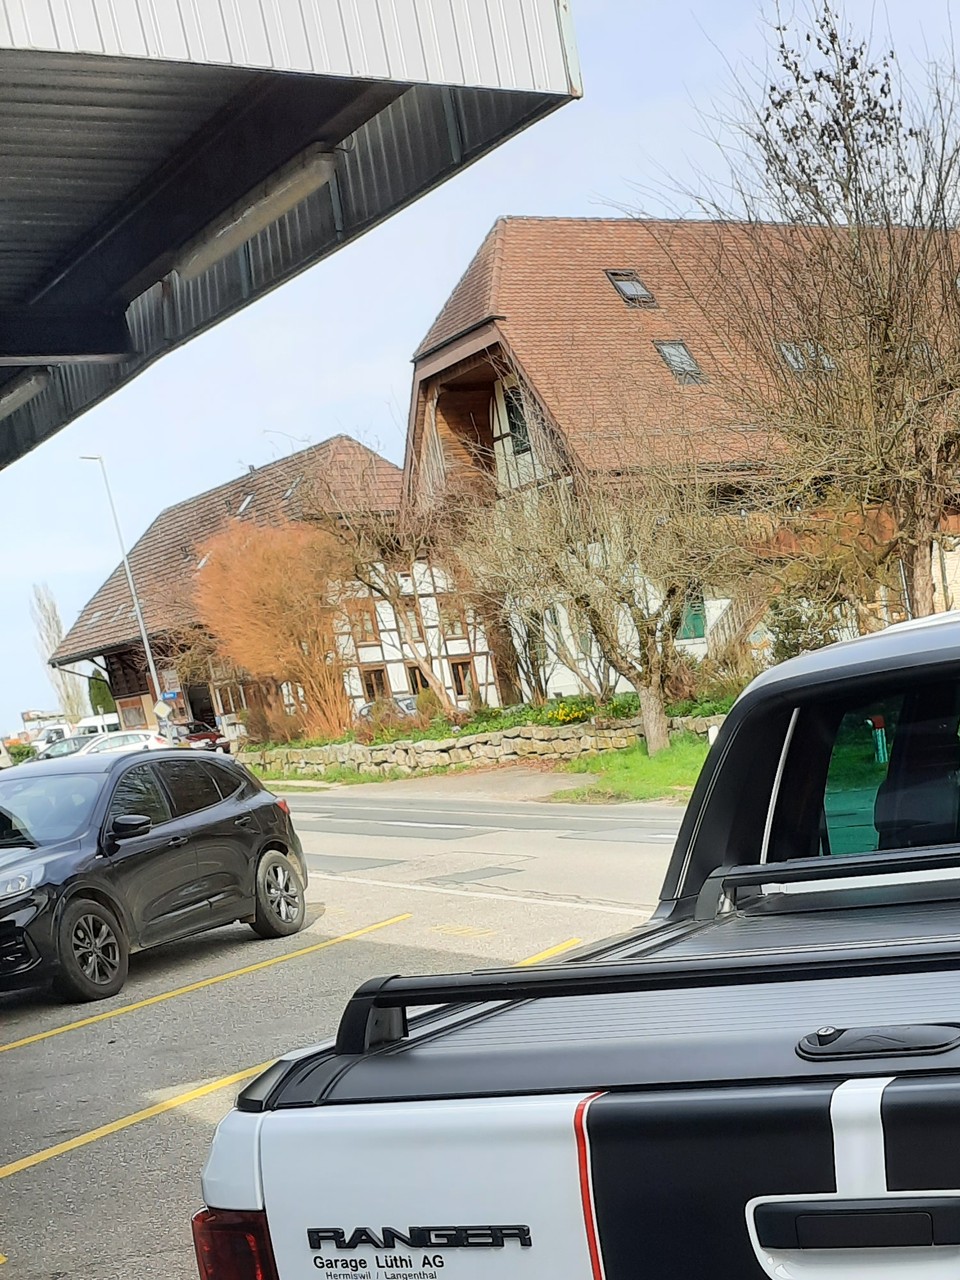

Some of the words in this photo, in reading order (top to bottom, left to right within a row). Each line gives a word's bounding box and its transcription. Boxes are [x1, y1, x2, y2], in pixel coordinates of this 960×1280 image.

[306, 1224, 533, 1250] RANGER
[313, 1255, 367, 1272] Garage
[376, 1255, 413, 1269] Lüthi
[421, 1255, 445, 1268] AG
[325, 1271, 371, 1280] Hermiswil
